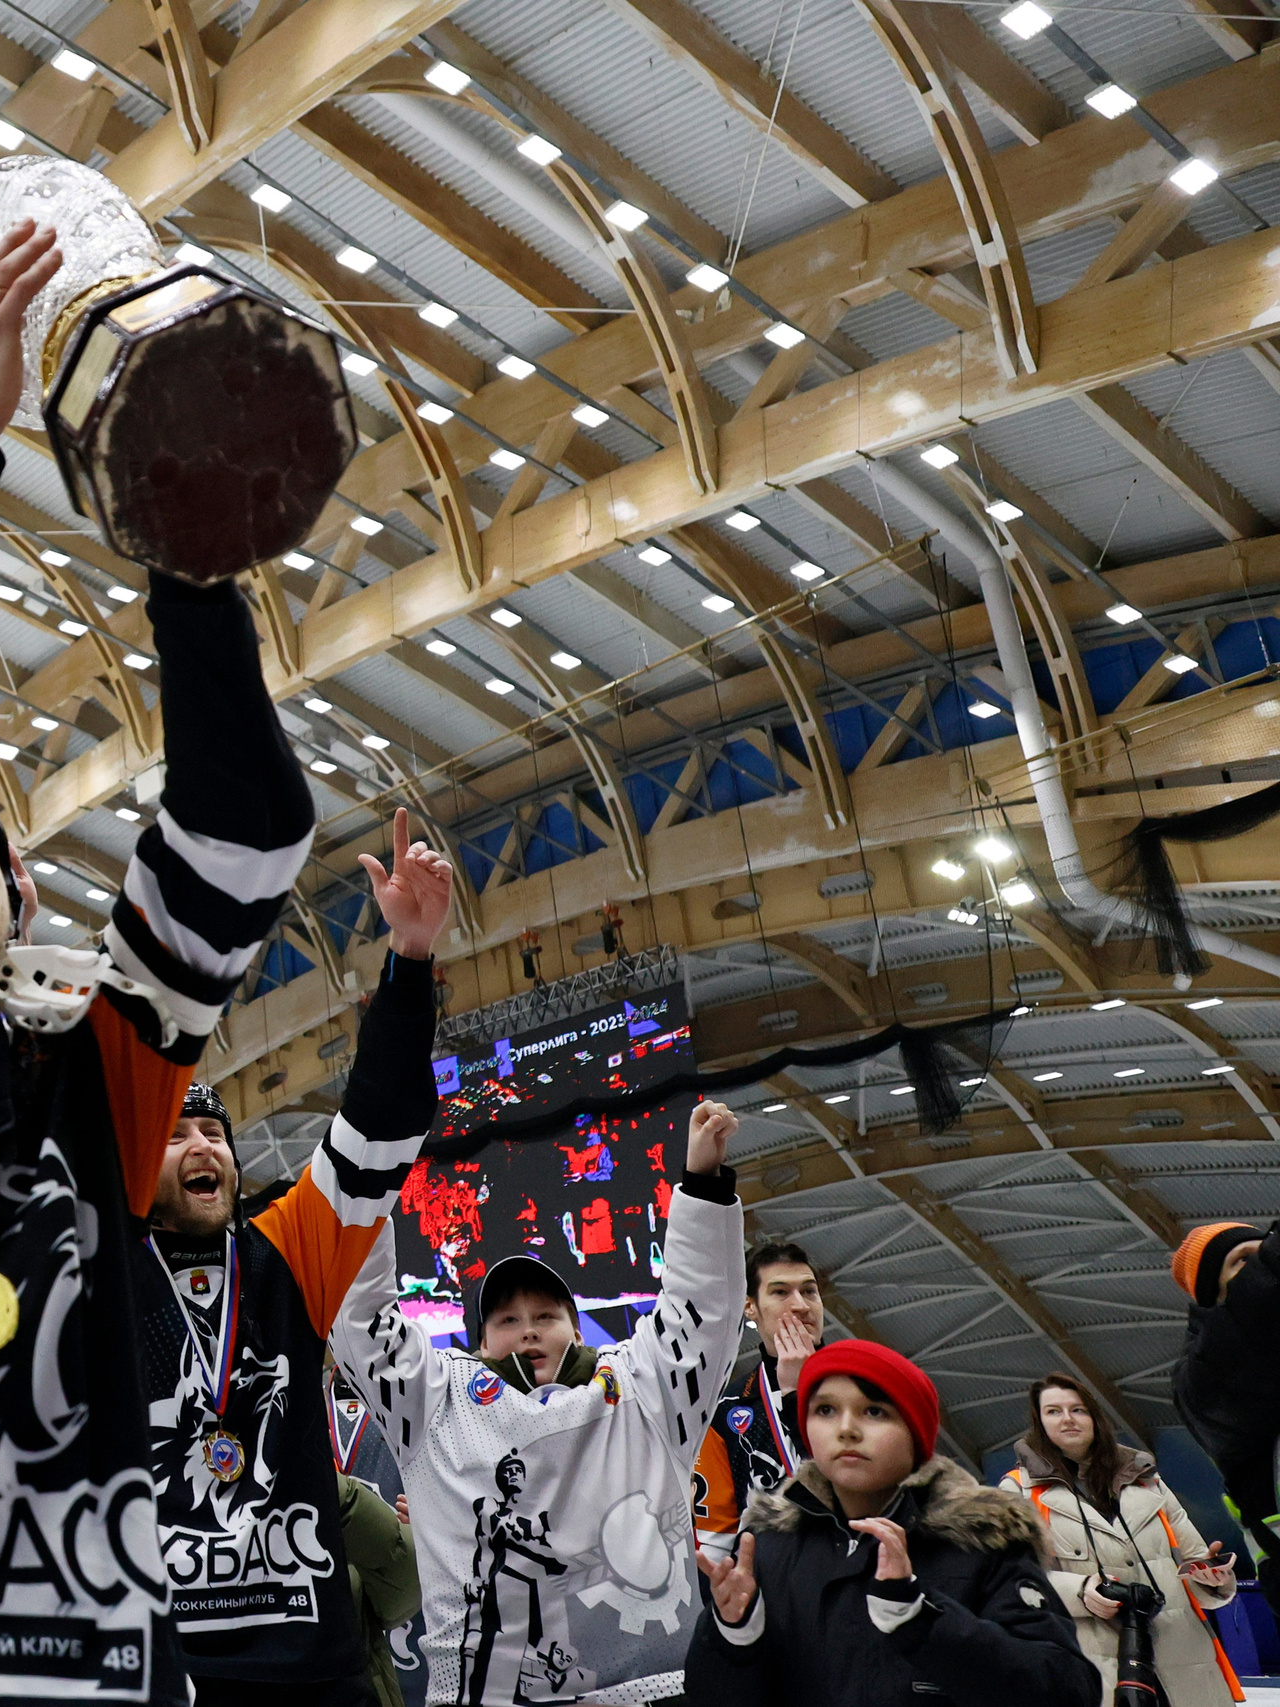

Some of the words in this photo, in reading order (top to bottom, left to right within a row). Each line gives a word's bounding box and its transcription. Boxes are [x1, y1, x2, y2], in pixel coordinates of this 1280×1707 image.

[507, 1029, 579, 1063] Суперлига
[169, 1250, 222, 1261] BAUER
[160, 1508, 333, 1587] ЗБАСС
[248, 1593, 276, 1605] КЛУБ
[287, 1594, 308, 1607] 48
[20, 1636, 84, 1660] КЛУБ
[102, 1644, 141, 1671] 48
